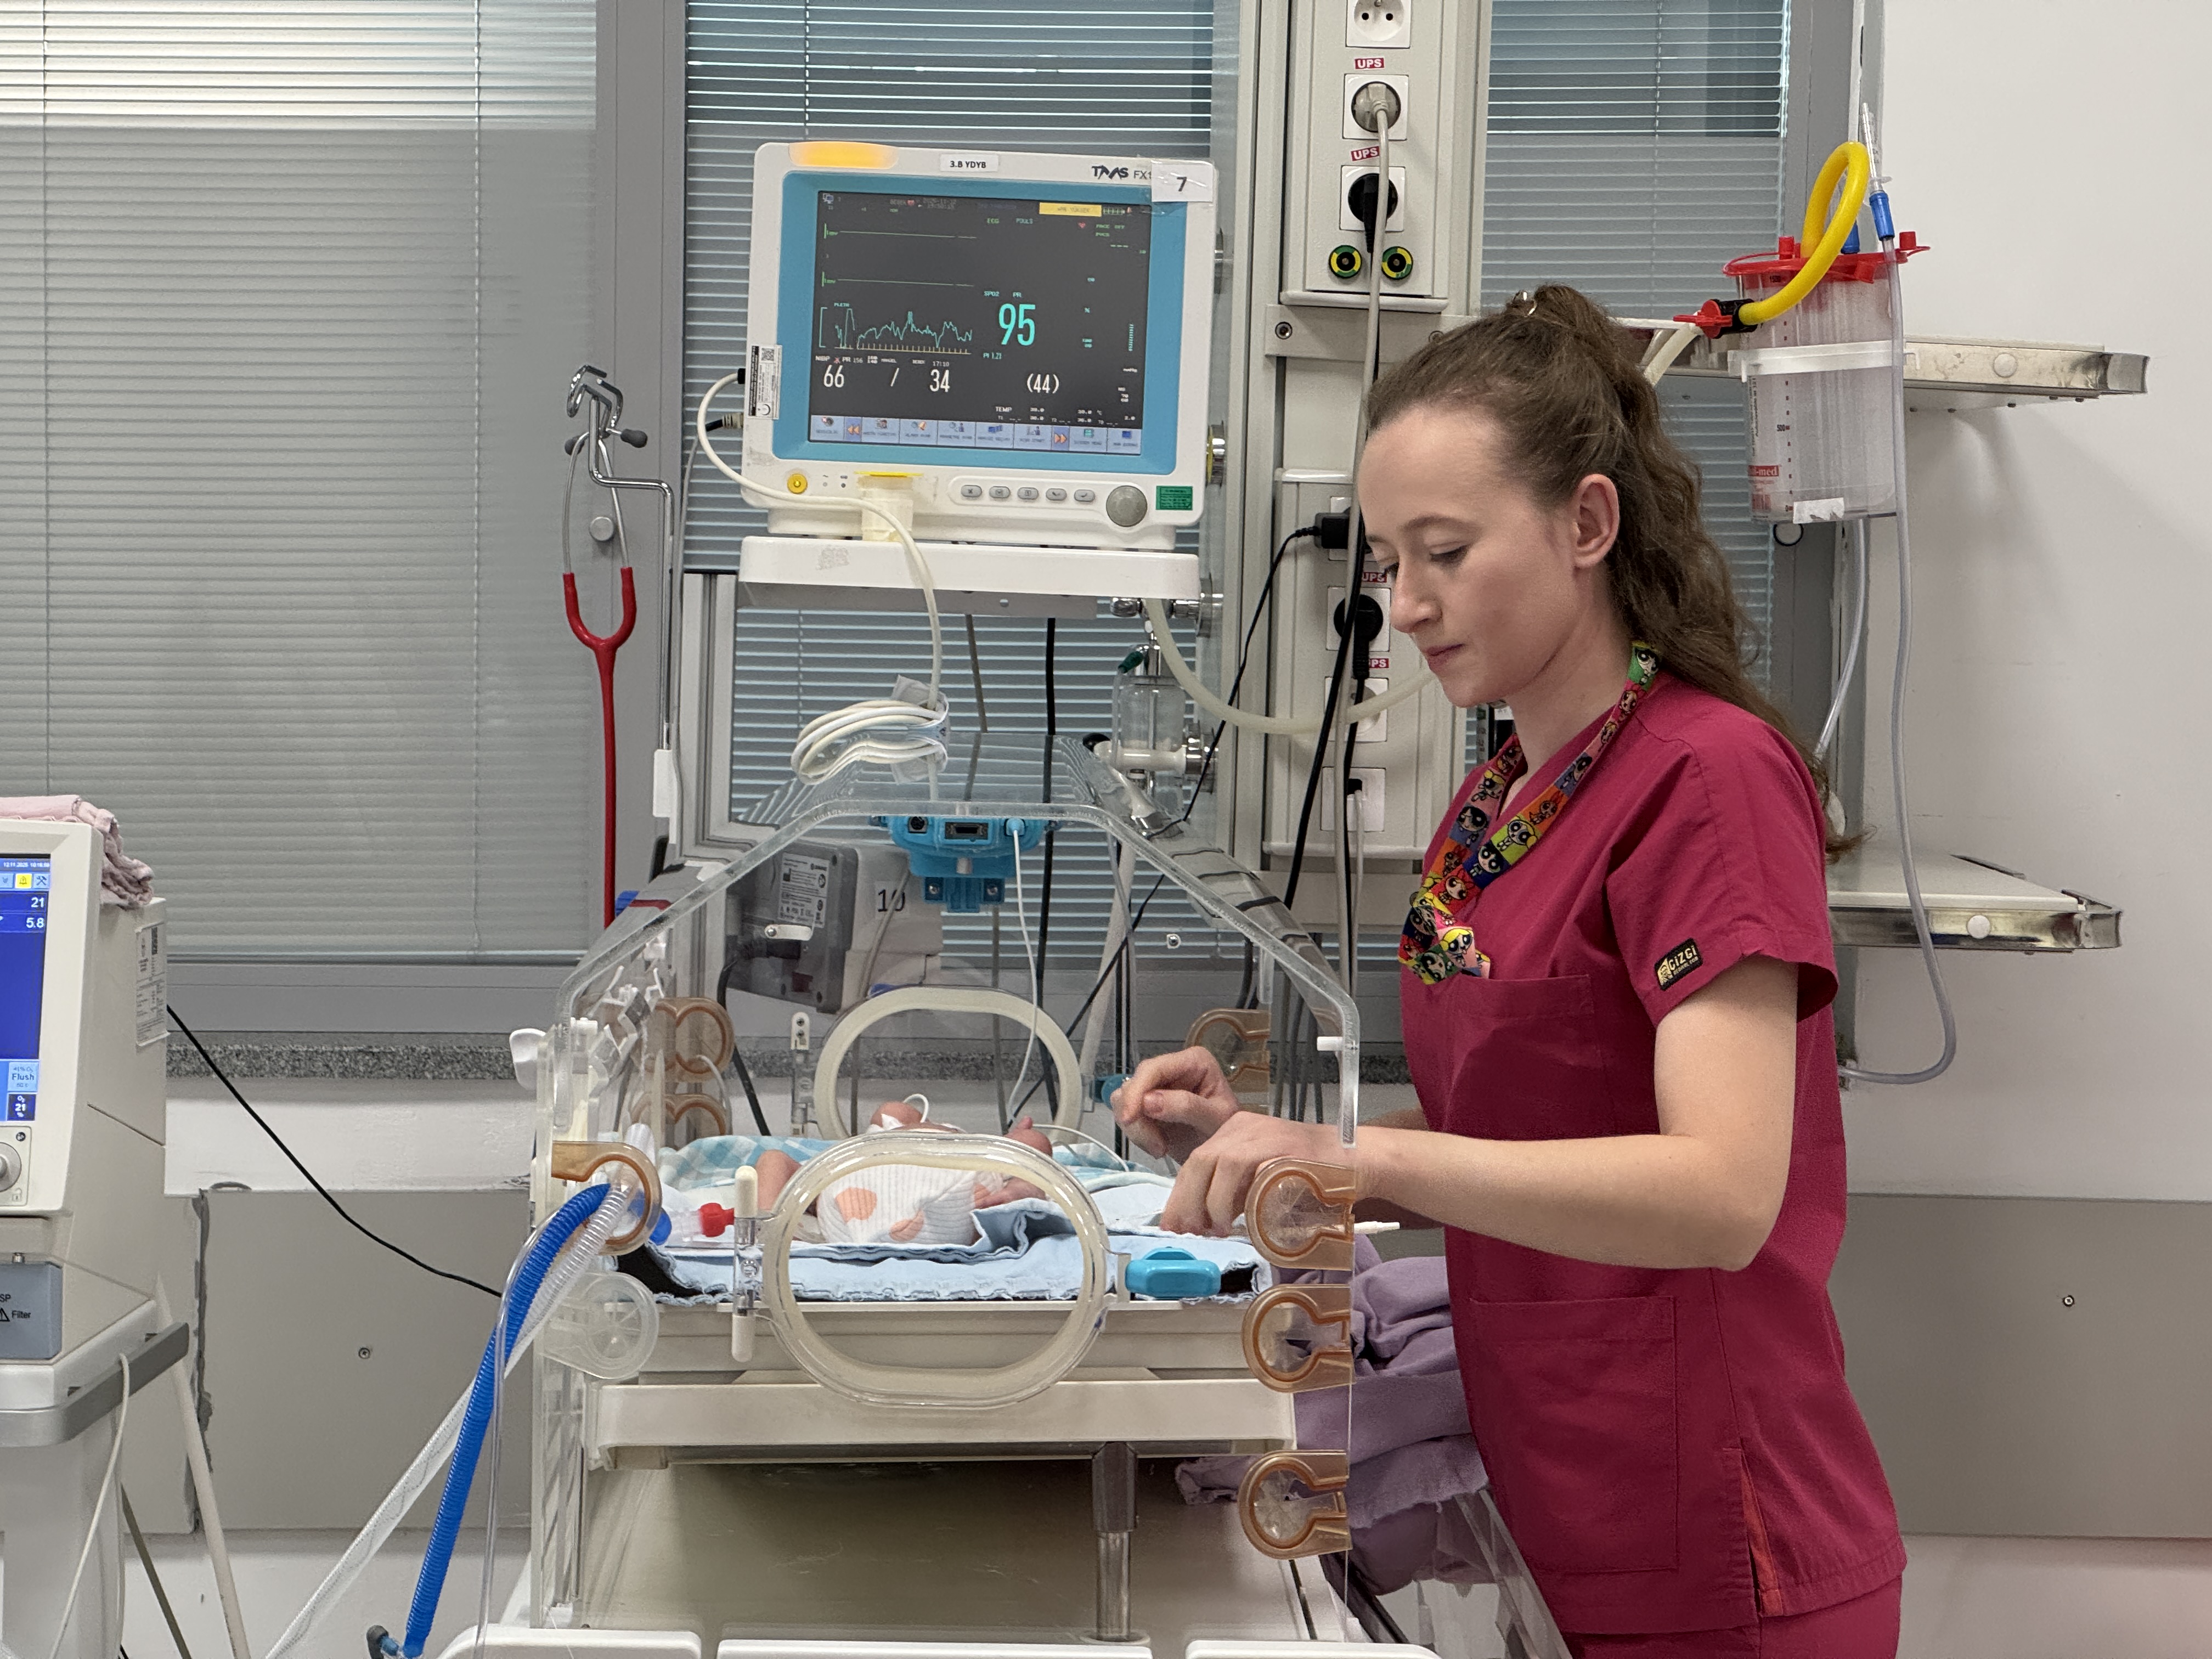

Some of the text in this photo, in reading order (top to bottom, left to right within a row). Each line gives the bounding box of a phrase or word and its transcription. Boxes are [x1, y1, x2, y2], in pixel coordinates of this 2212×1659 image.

[1357, 59, 1382, 68] UPS
[1353, 147, 1379, 160] UPS
[1177, 176, 1187, 192] 7
[998, 303, 1036, 346] 95
[823, 364, 845, 388] 66
[929, 369, 950, 392] 34
[1026, 373, 1059, 394] (44)
[31, 896, 44, 908] 21
[878, 889, 905, 912] 10
[26, 917, 44, 929] 5.8
[12, 1073, 35, 1081] Flush
[15, 1103, 25, 1111] 21
[12, 1310, 31, 1318] Filter
